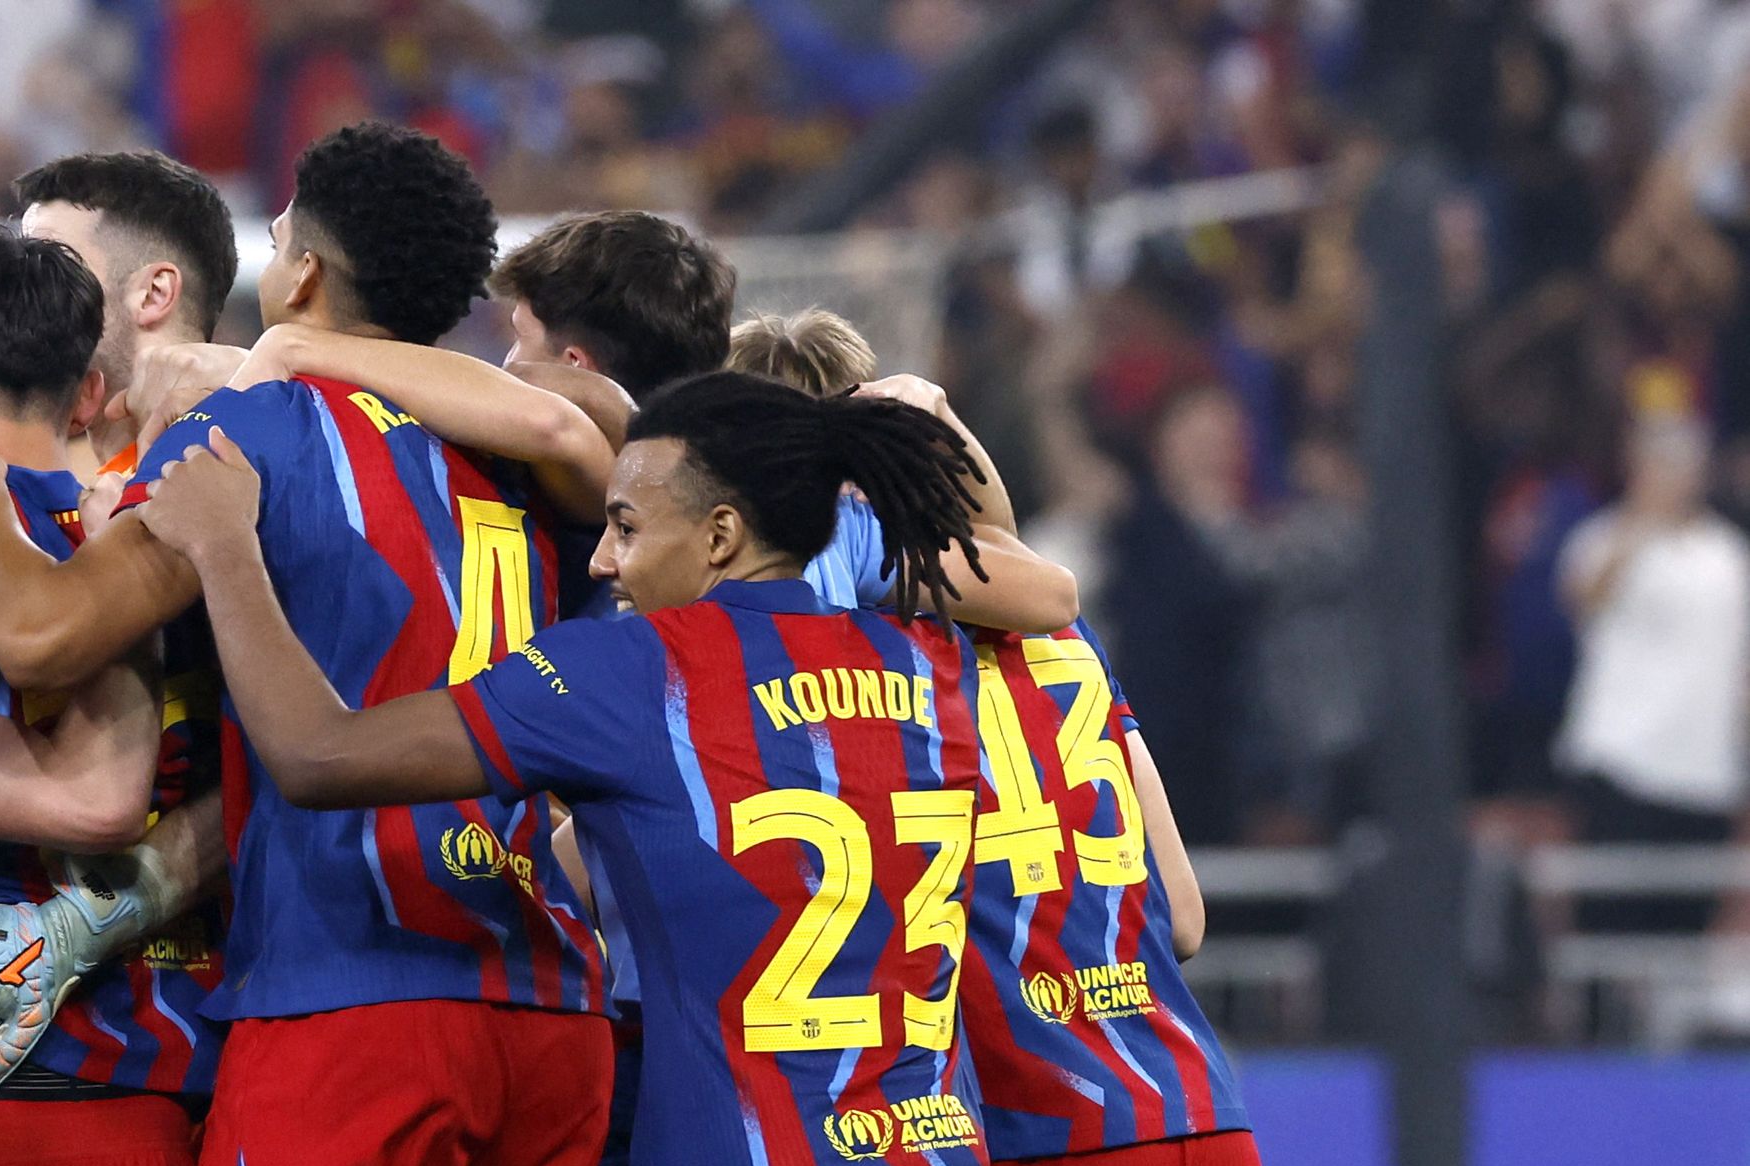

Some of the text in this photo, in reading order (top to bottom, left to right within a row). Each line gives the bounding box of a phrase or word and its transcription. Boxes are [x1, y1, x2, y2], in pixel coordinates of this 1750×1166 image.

[550, 677, 569, 695] tv
[752, 668, 933, 731] KOUNDE
[974, 638, 1148, 897] 43
[730, 788, 975, 1052] 23
[1074, 961, 1148, 990] UNHCR
[1083, 984, 1153, 1012] ACNUR
[890, 1093, 968, 1121] UNHCR
[900, 1115, 976, 1144] ACNUR
